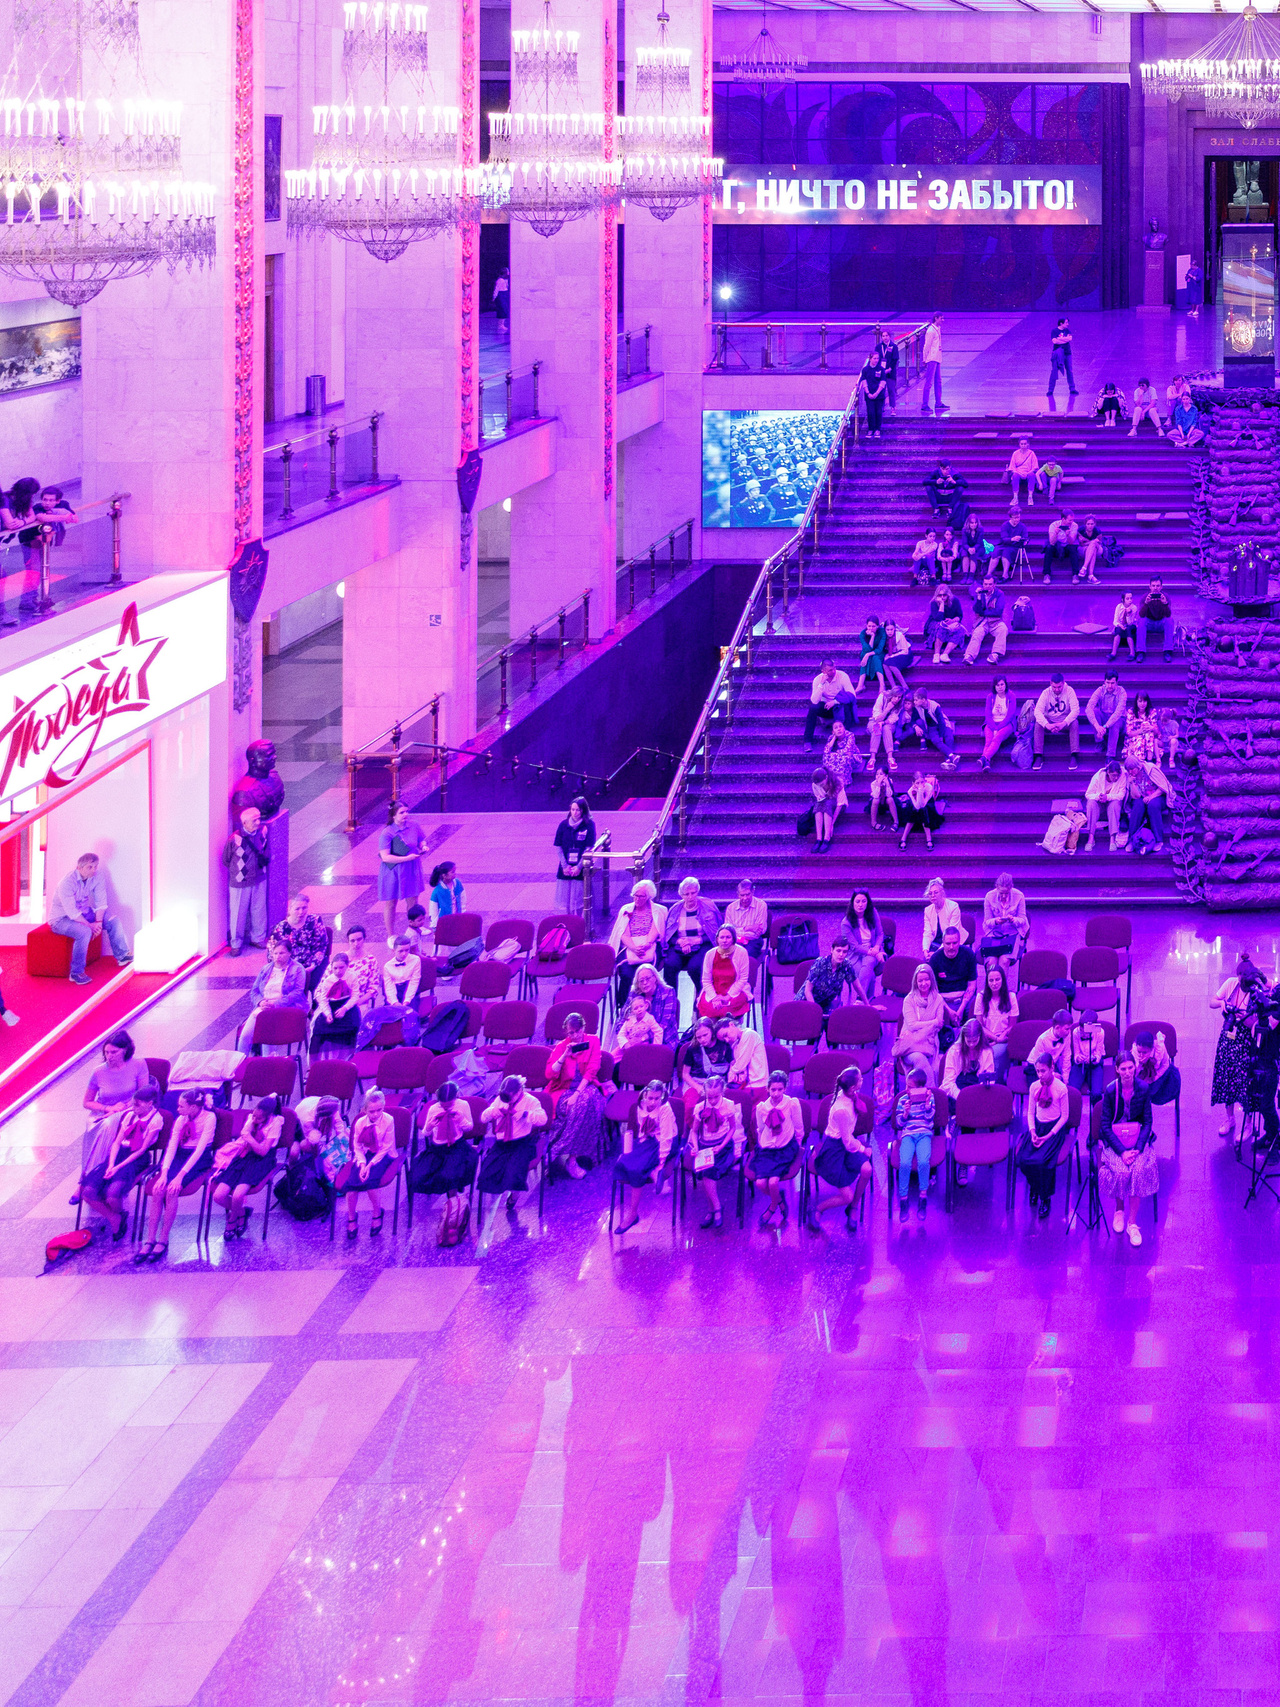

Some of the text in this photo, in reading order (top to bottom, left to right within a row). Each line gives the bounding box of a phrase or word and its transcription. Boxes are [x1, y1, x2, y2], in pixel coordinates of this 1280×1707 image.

[1210, 138, 1234, 146] ЗАЛ
[756, 179, 866, 211] НИЧТО
[877, 179, 918, 210] НЕ
[928, 179, 1074, 211] ЗАБЫТО!
